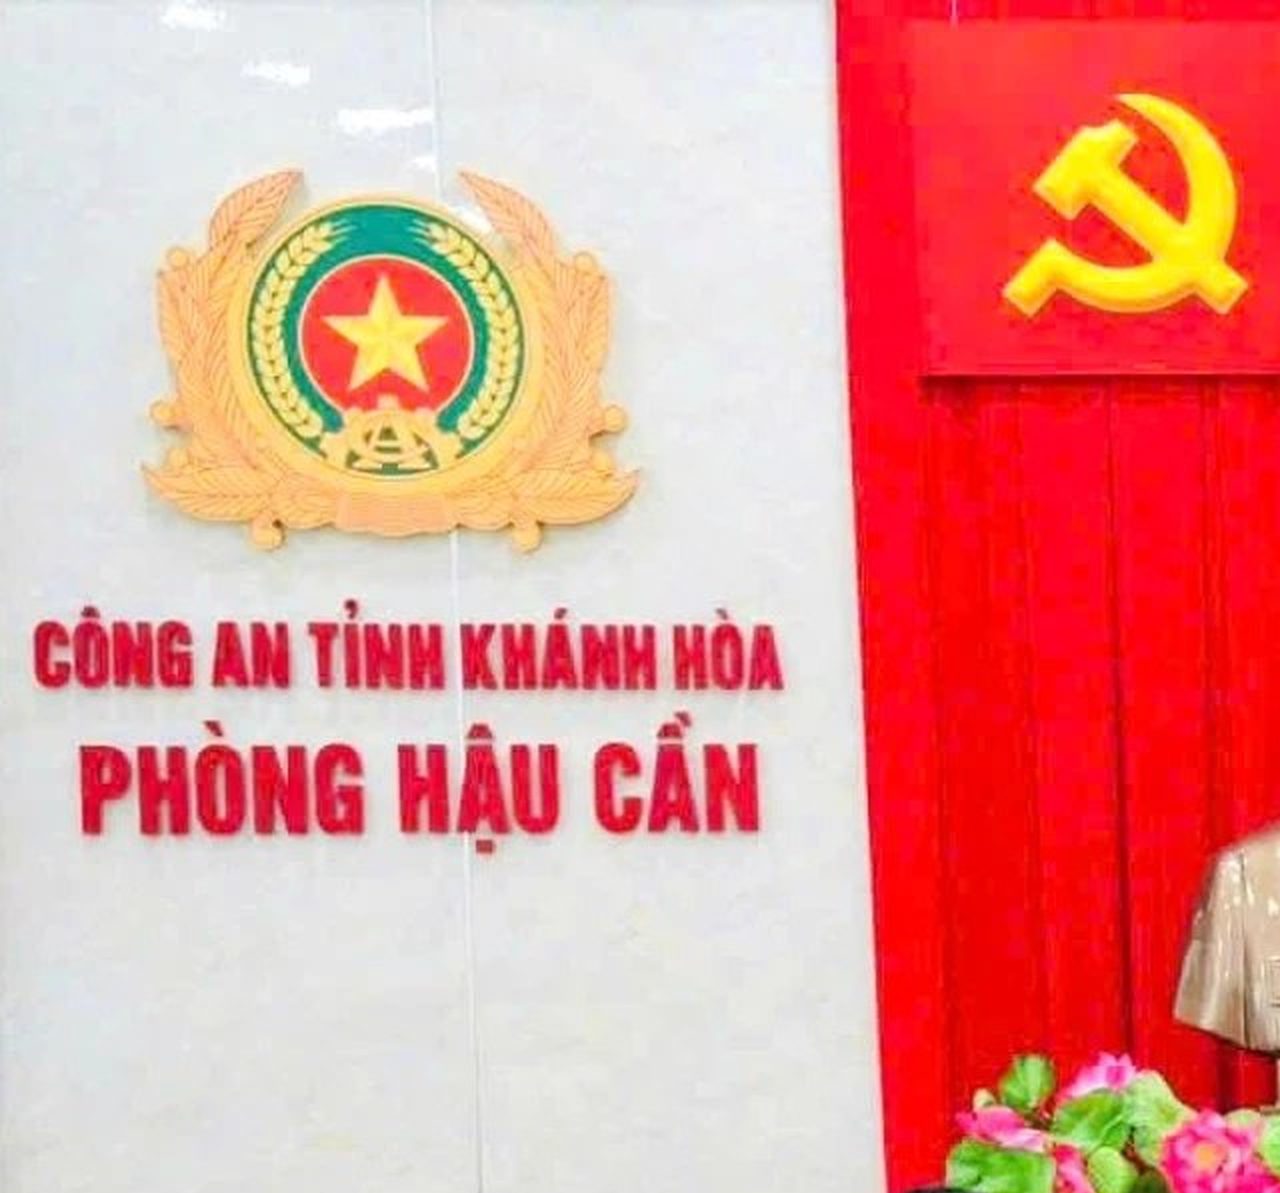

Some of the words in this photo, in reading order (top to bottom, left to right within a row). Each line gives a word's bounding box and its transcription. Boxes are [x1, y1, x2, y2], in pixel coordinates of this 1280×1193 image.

[33, 605, 193, 690] CÔNG
[212, 621, 290, 690] AN
[309, 598, 445, 690] TỈNH
[461, 608, 657, 690] KHÁNH
[674, 610, 784, 690] HÒA
[79, 721, 365, 837] PHÒNG
[399, 723, 558, 853] HẬU
[595, 712, 760, 836] CẦN
